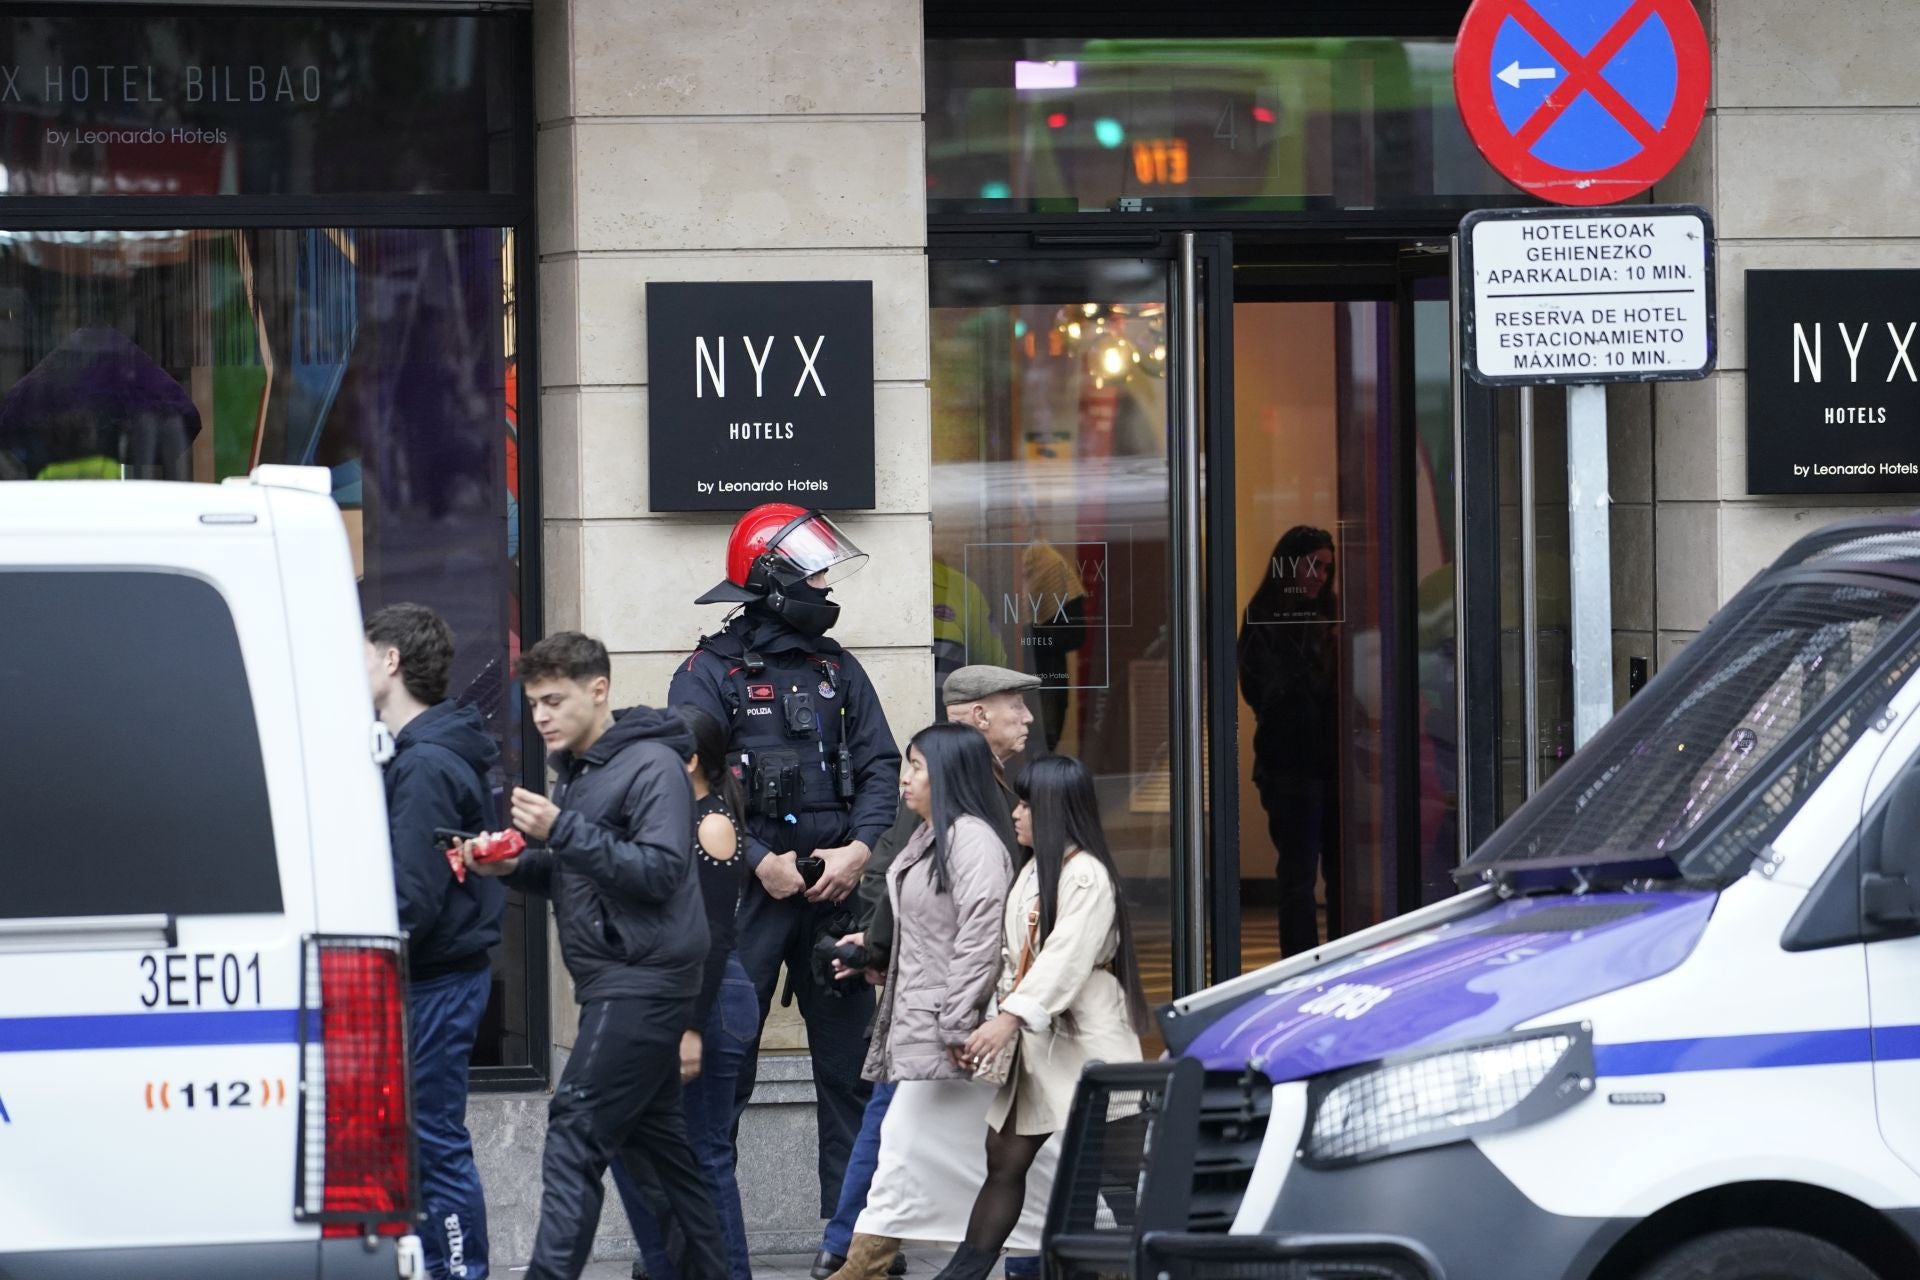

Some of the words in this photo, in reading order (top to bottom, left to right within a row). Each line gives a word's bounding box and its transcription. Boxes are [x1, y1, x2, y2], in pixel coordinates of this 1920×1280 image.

[46, 65, 163, 102] HOTEL
[186, 65, 320, 102] BILBAO
[1213, 98, 1239, 150] 4
[46, 128, 70, 146] by
[75, 128, 165, 144] Leonardo
[171, 128, 227, 144] Hotels
[1522, 222, 1656, 241] HOTELEKOAK
[1526, 244, 1652, 262] GEHIENEZKO
[1487, 266, 1618, 285] APARKALDIA:
[1625, 265, 1646, 280] 10
[1652, 264, 1692, 280] MIN.
[1495, 310, 1585, 327] RESERVA
[1592, 309, 1617, 324] DE
[1624, 307, 1687, 323] HOTEL
[1500, 328, 1684, 348] ESTACIONAMIENTO
[1514, 350, 1598, 369] MÁXIMO:
[1605, 351, 1625, 366] 10
[1632, 350, 1671, 365] MIN.
[1793, 322, 1918, 383] NYX
[695, 335, 827, 398] NYX
[1824, 407, 1886, 424] HOTELS
[729, 422, 794, 440] HOTELS
[1793, 463, 1810, 478] by
[1813, 462, 1876, 475] Leonardo
[1879, 462, 1919, 475] Hotels
[697, 480, 715, 495] by
[718, 479, 783, 493] Leonardo
[787, 479, 829, 491] Hotels
[1272, 556, 1318, 578] NYX
[1003, 592, 1070, 625] NYX
[1020, 636, 1053, 646] HOTELS
[747, 707, 772, 716] POLIZIA
[140, 952, 261, 1008] 3EF01
